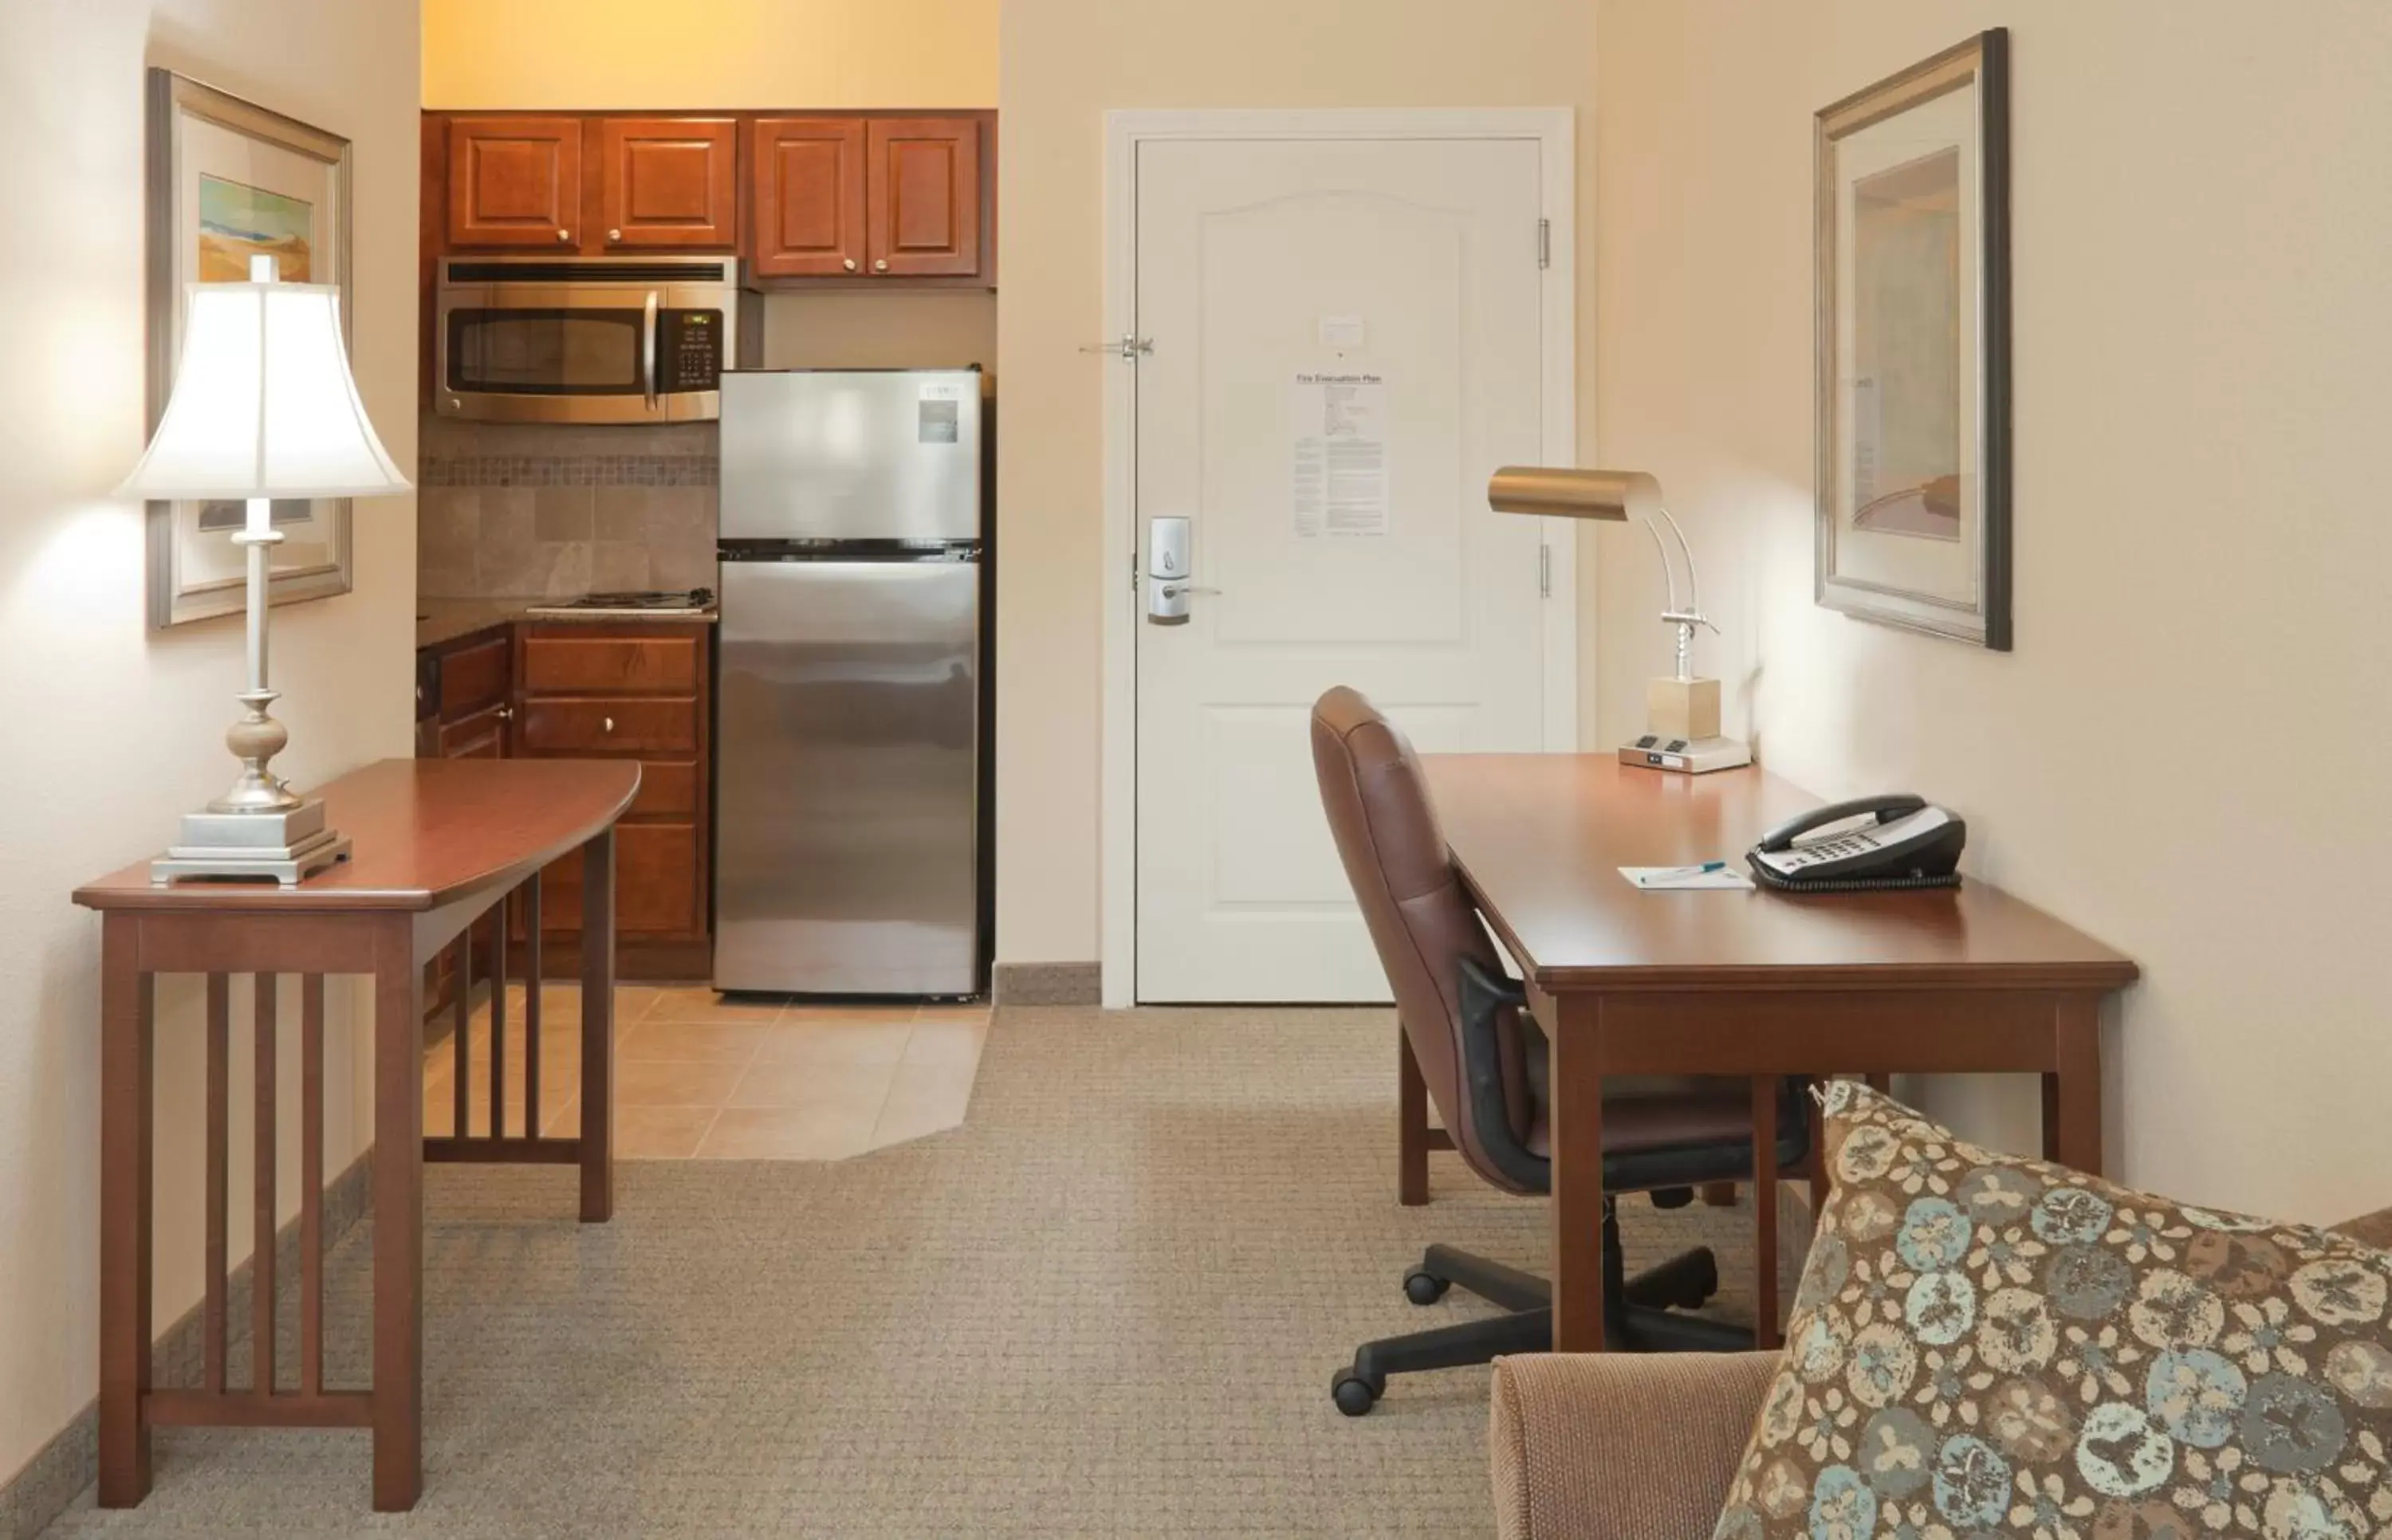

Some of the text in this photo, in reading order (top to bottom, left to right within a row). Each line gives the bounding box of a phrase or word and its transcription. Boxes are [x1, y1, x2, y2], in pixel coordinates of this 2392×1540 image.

[1296, 373, 1381, 383] Fire Evacuation Plan
